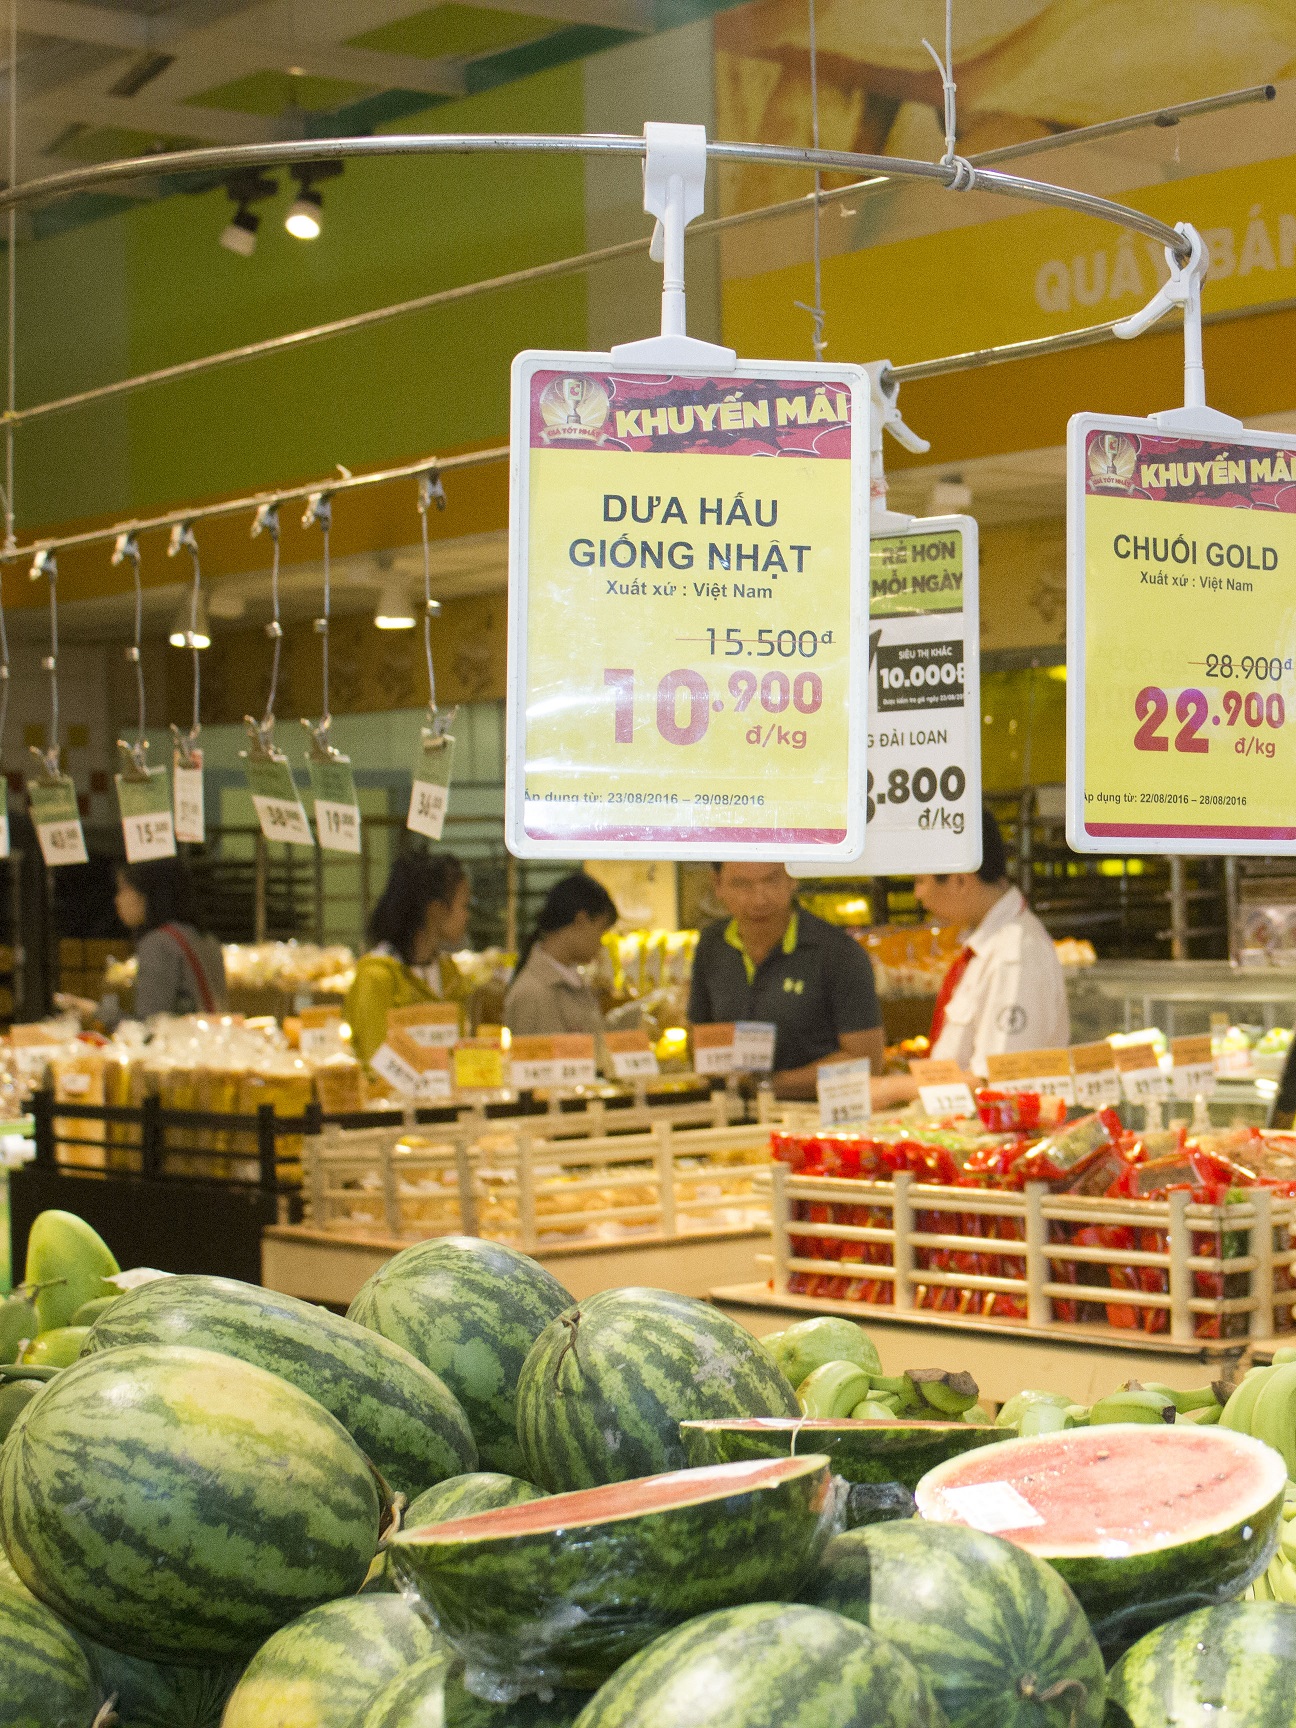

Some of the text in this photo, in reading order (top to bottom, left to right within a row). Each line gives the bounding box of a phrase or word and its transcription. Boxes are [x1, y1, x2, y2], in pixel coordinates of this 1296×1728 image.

[615, 387, 849, 438] KHUYẾN MÃI
[1140, 452, 1246, 488] KHUYẾN
[603, 492, 778, 527] DƯA HẤU
[568, 533, 811, 579] GIỐNG NHẬT
[882, 540, 956, 566] RẺ HƠN
[1113, 533, 1278, 571] CHUỐI GOLD
[606, 578, 647, 596] Xuất
[652, 580, 678, 597] xứ
[693, 582, 728, 600] Việt
[733, 585, 773, 599] Nam
[871, 570, 963, 597] MỖI NGÀY
[1140, 571, 1168, 586] Xuất
[1172, 574, 1189, 587] xứ
[1200, 576, 1223, 592] Việt
[1227, 579, 1253, 592] Nam
[898, 645, 953, 660] SIÊU THỊ KHÁC
[604, 668, 823, 746] 10.900
[1134, 686, 1285, 754] 22.900
[746, 723, 807, 749] đ/kg
[880, 728, 905, 748] ĐÀI
[910, 729, 948, 746] LOAN
[1234, 736, 1276, 758] đ/kg
[607, 793, 679, 806] 23/08/2016
[694, 794, 765, 806] 29/08/2016
[1096, 792, 1121, 805] dụng
[1123, 791, 1138, 804] từ:
[1140, 793, 1189, 805] 22/08/2016
[1200, 794, 1247, 806] 28/08/2016
[918, 807, 965, 835] đ/kg
